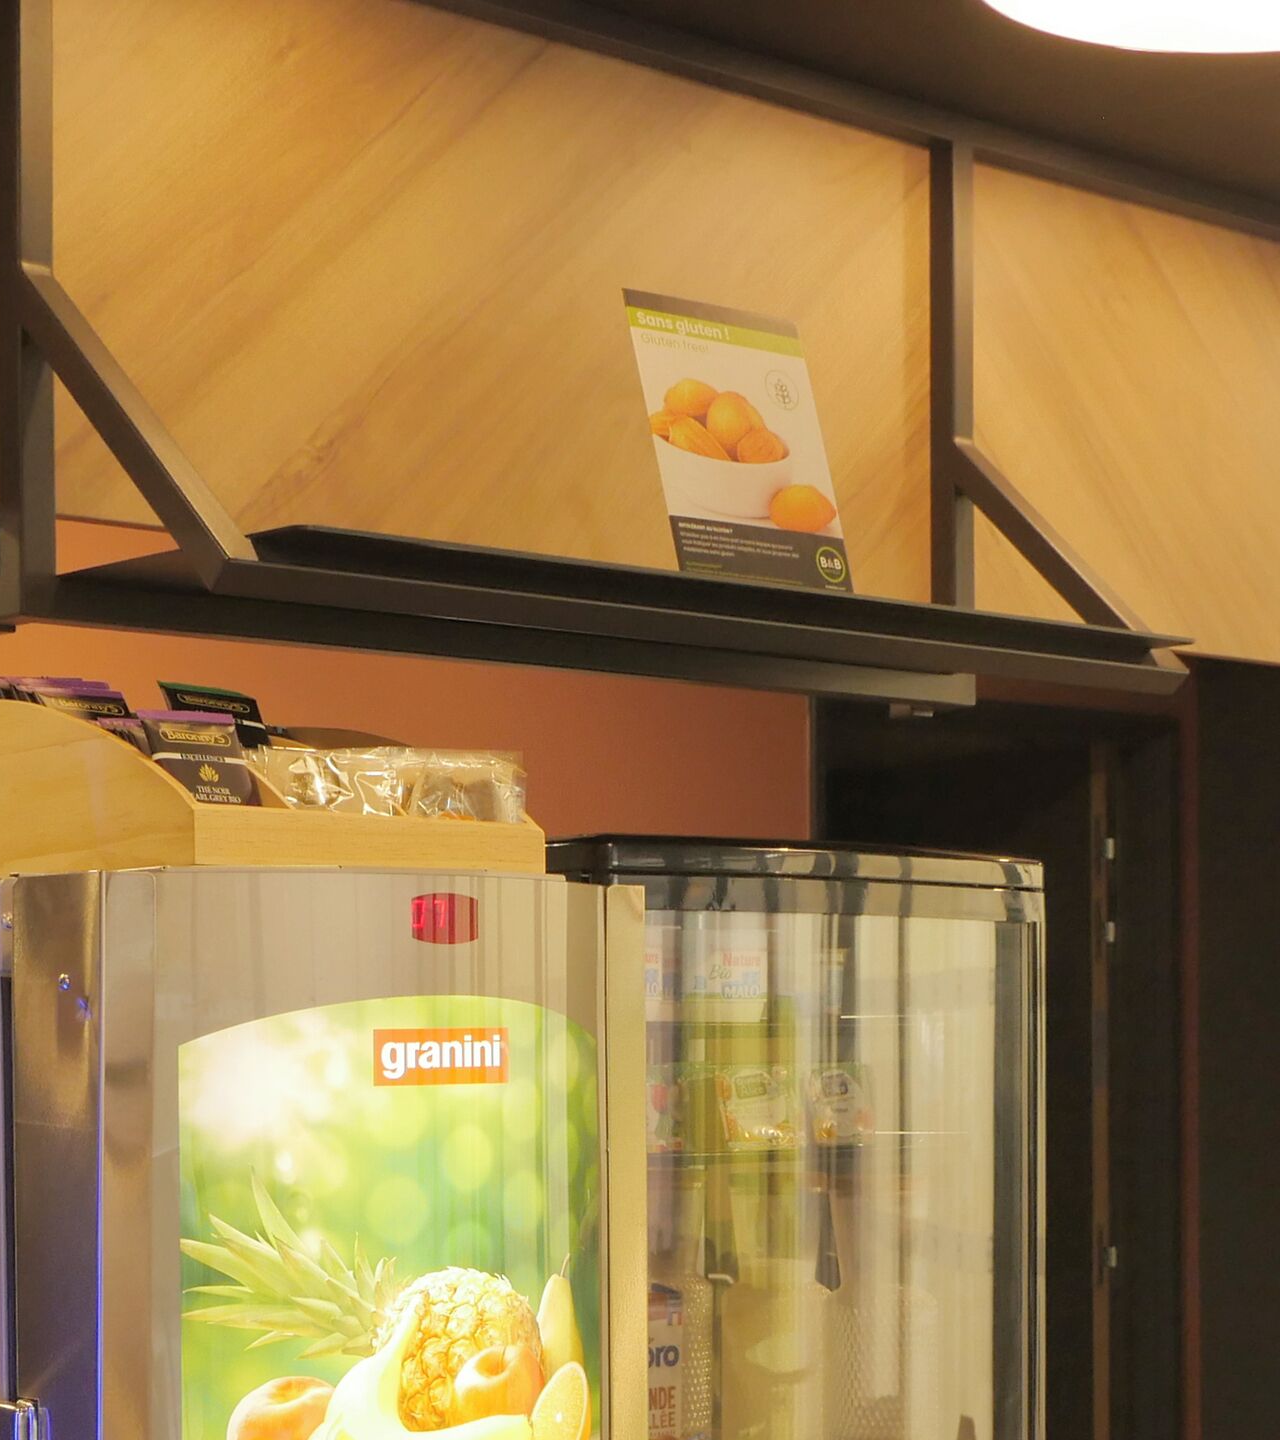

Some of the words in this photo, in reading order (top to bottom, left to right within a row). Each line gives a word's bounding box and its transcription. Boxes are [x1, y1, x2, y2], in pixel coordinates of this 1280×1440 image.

[636, 311, 673, 329] Sans
[676, 319, 722, 340] gluten
[819, 556, 842, 571] B&B
[211, 787, 230, 795] NOIR
[722, 982, 760, 999] MALO
[380, 1034, 501, 1080] granini
